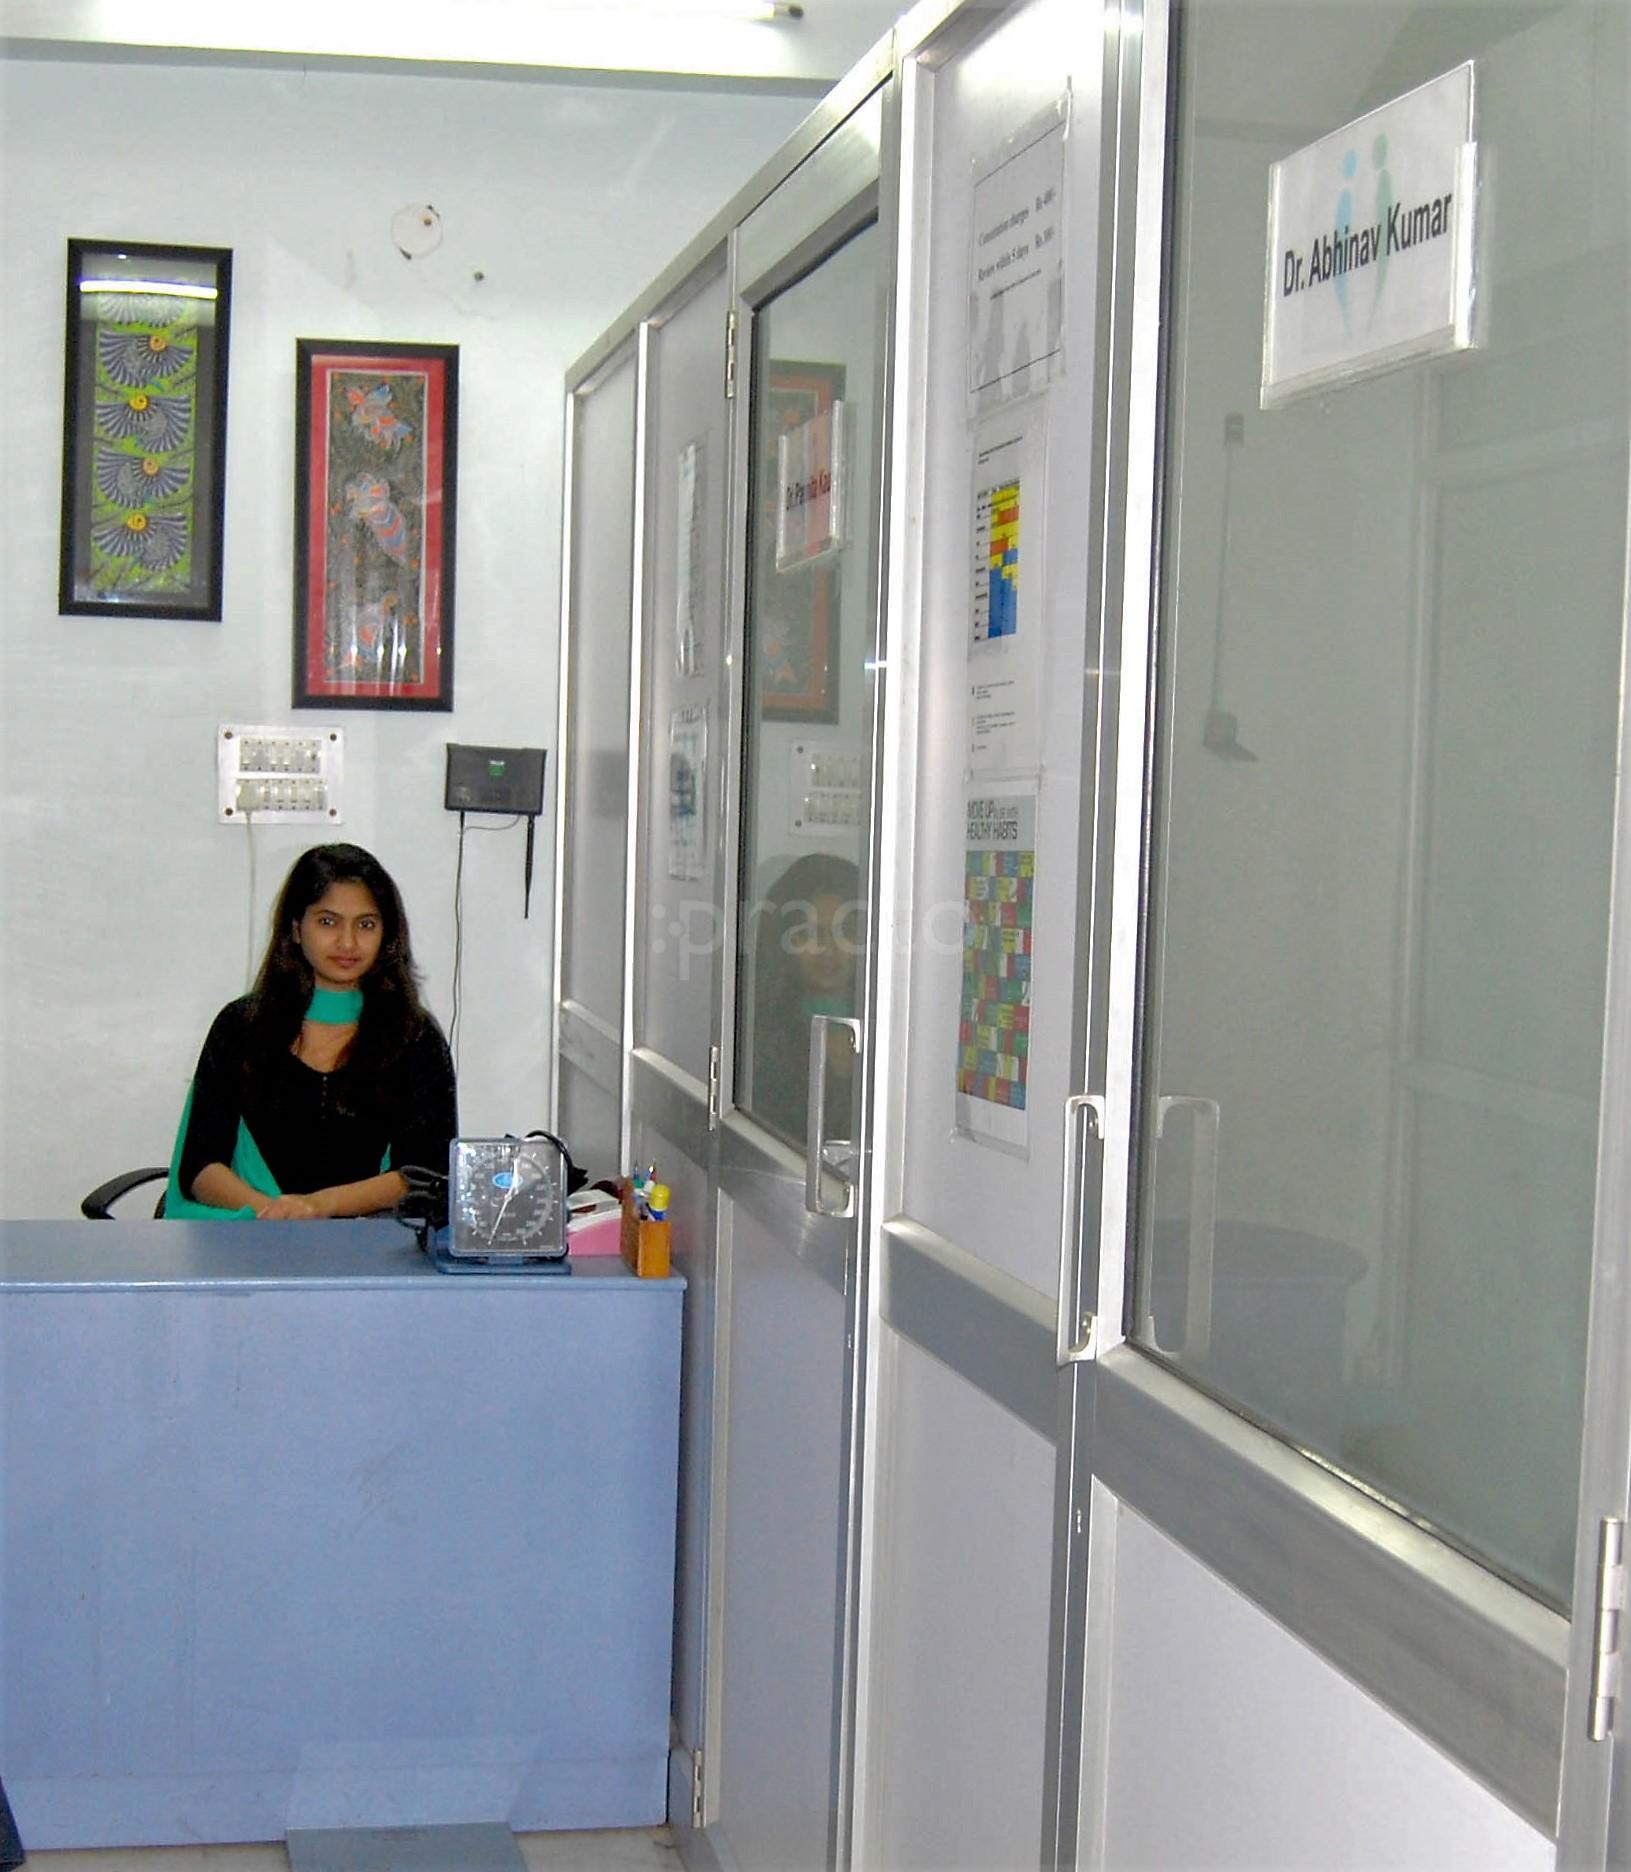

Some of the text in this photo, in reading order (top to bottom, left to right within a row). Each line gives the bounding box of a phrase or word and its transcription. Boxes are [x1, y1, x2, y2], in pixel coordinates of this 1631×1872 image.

[1283, 193, 1452, 297] Dr. Abhinav Kumar
[967, 820, 1018, 841] HEALTHY HABITS
